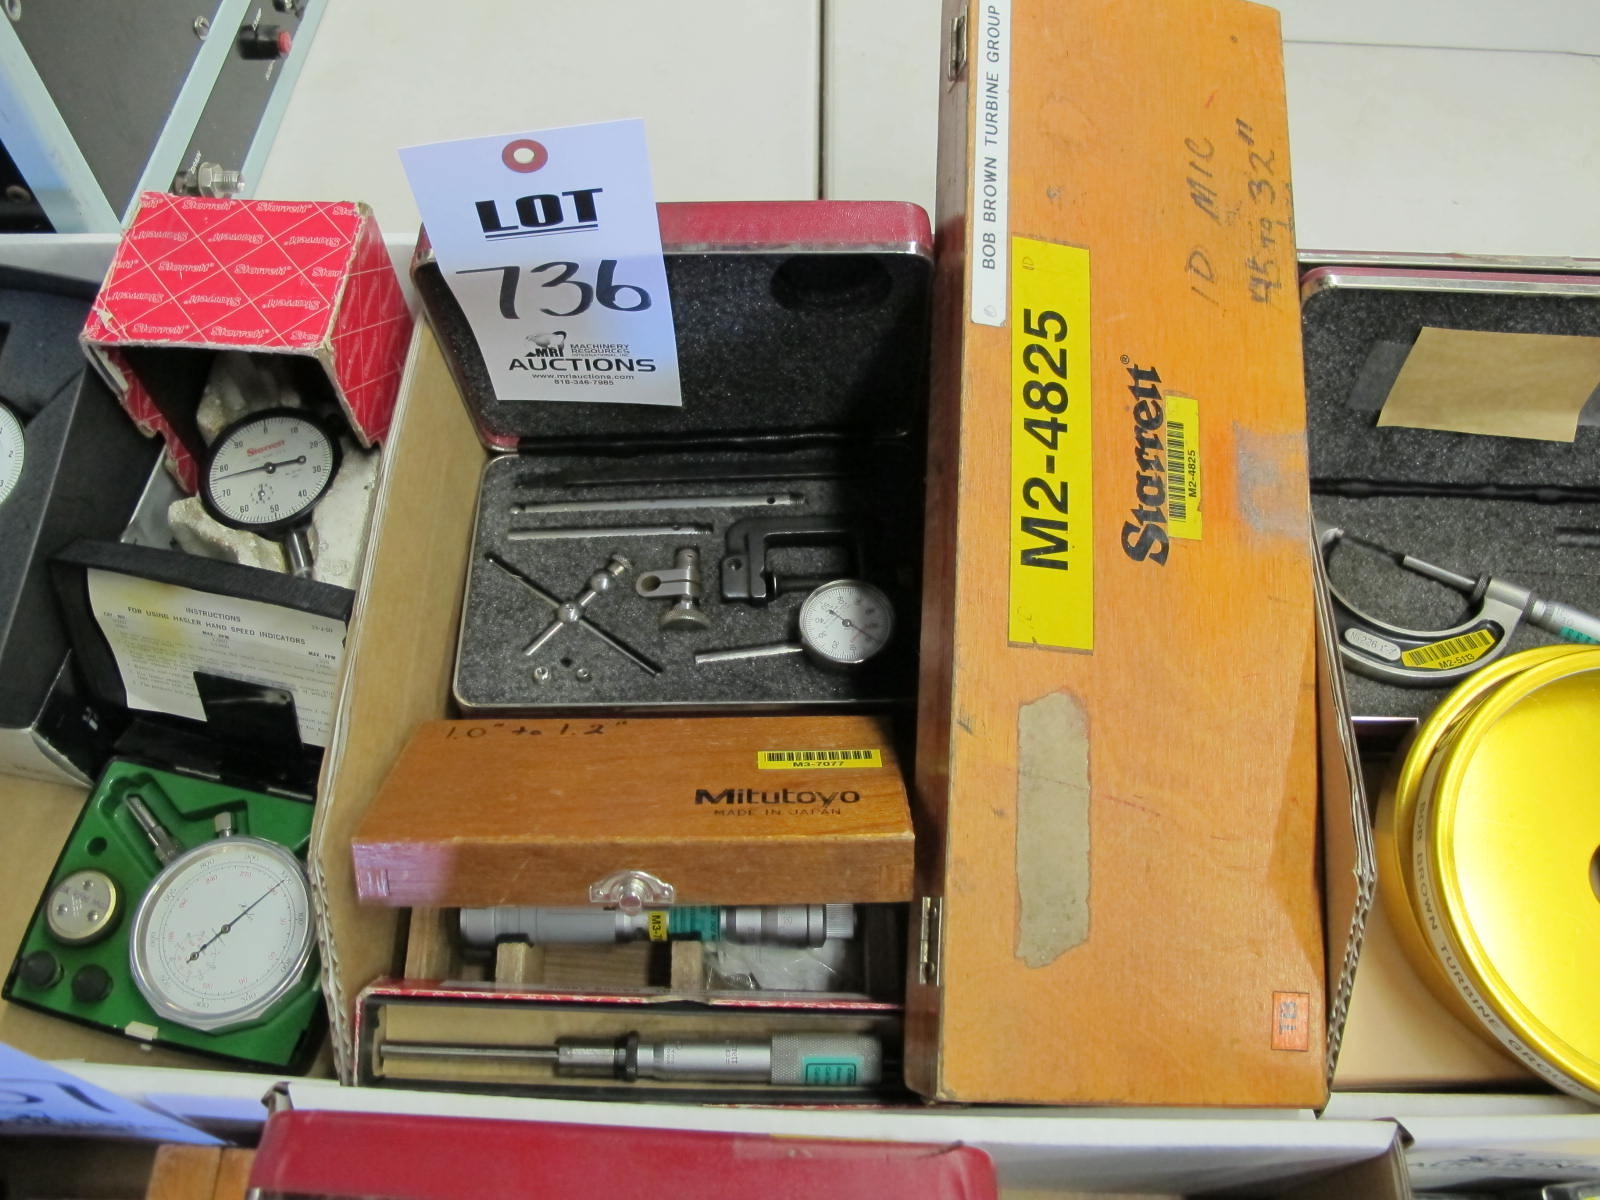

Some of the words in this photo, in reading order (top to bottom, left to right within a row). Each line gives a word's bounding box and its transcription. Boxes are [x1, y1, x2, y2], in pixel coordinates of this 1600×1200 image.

[986, 5, 1001, 63] GROUP
[984, 72, 1000, 147] TURBINE
[475, 187, 603, 233] LOT
[983, 156, 998, 223] BROWN
[981, 232, 997, 270] BOB
[456, 260, 652, 320] 736
[508, 358, 656, 372] AUCTIONS
[1020, 308, 1069, 571] M2-4825
[1187, 448, 1198, 498] M2-4825
[127, 606, 143, 615] FOR
[205, 620, 228, 632] HAND
[231, 625, 256, 636] SPEED
[259, 631, 307, 646] INDICATORS
[185, 607, 242, 623] INSTRUCTIONS
[1438, 653, 1475, 670] M2-5113
[694, 788, 861, 808] Mitutoyo
[714, 808, 752, 816] MADE
[788, 807, 842, 816] JAPAN
[1414, 801, 1427, 842] BOB
[1416, 848, 1438, 931] BROWN
[1440, 944, 1498, 1028] TURBINE
